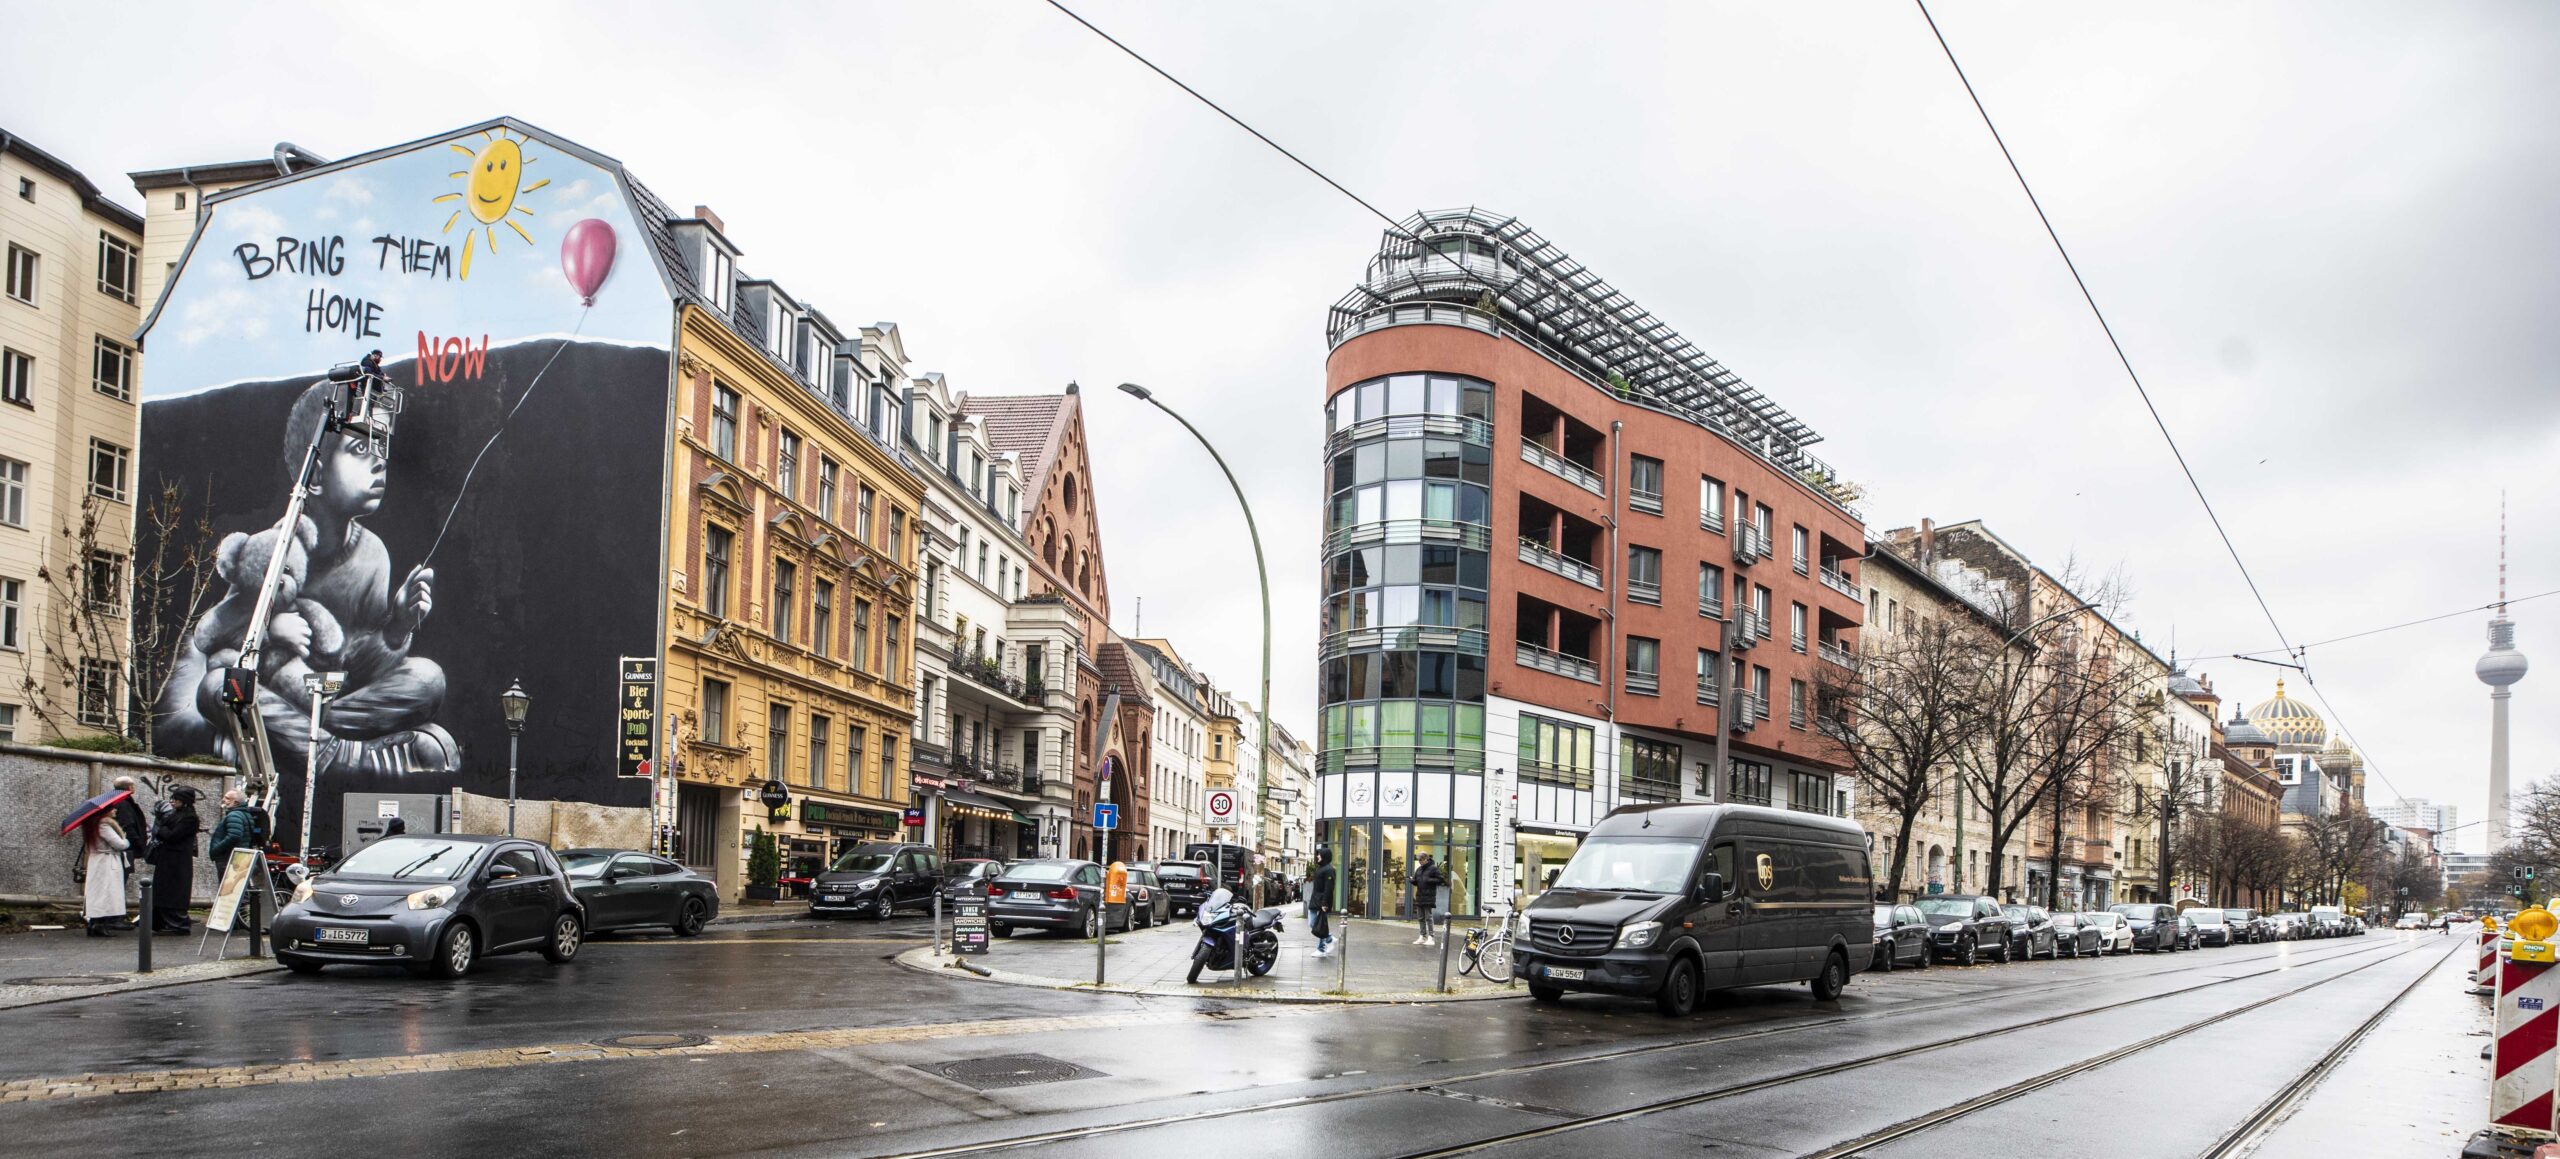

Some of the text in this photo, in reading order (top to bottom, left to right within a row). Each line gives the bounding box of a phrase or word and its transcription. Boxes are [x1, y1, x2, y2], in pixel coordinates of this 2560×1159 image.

[233, 233, 452, 281] BRING THEM
[306, 288, 384, 340] HOME
[415, 330, 489, 386] NOW
[624, 672, 652, 680] GUINNESS
[629, 685, 649, 697] Bier
[634, 697, 642, 708] &
[623, 708, 653, 721] Sports-
[1214, 798, 1228, 810] 30
[808, 805, 826, 821] PUB
[838, 828, 863, 837] WELCOME
[1492, 800, 1502, 861] Zahnretter
[1492, 865, 1500, 898] Berlin
[1760, 865, 1773, 885] ups
[321, 929, 327, 938] B
[344, 930, 367, 941] 5772
